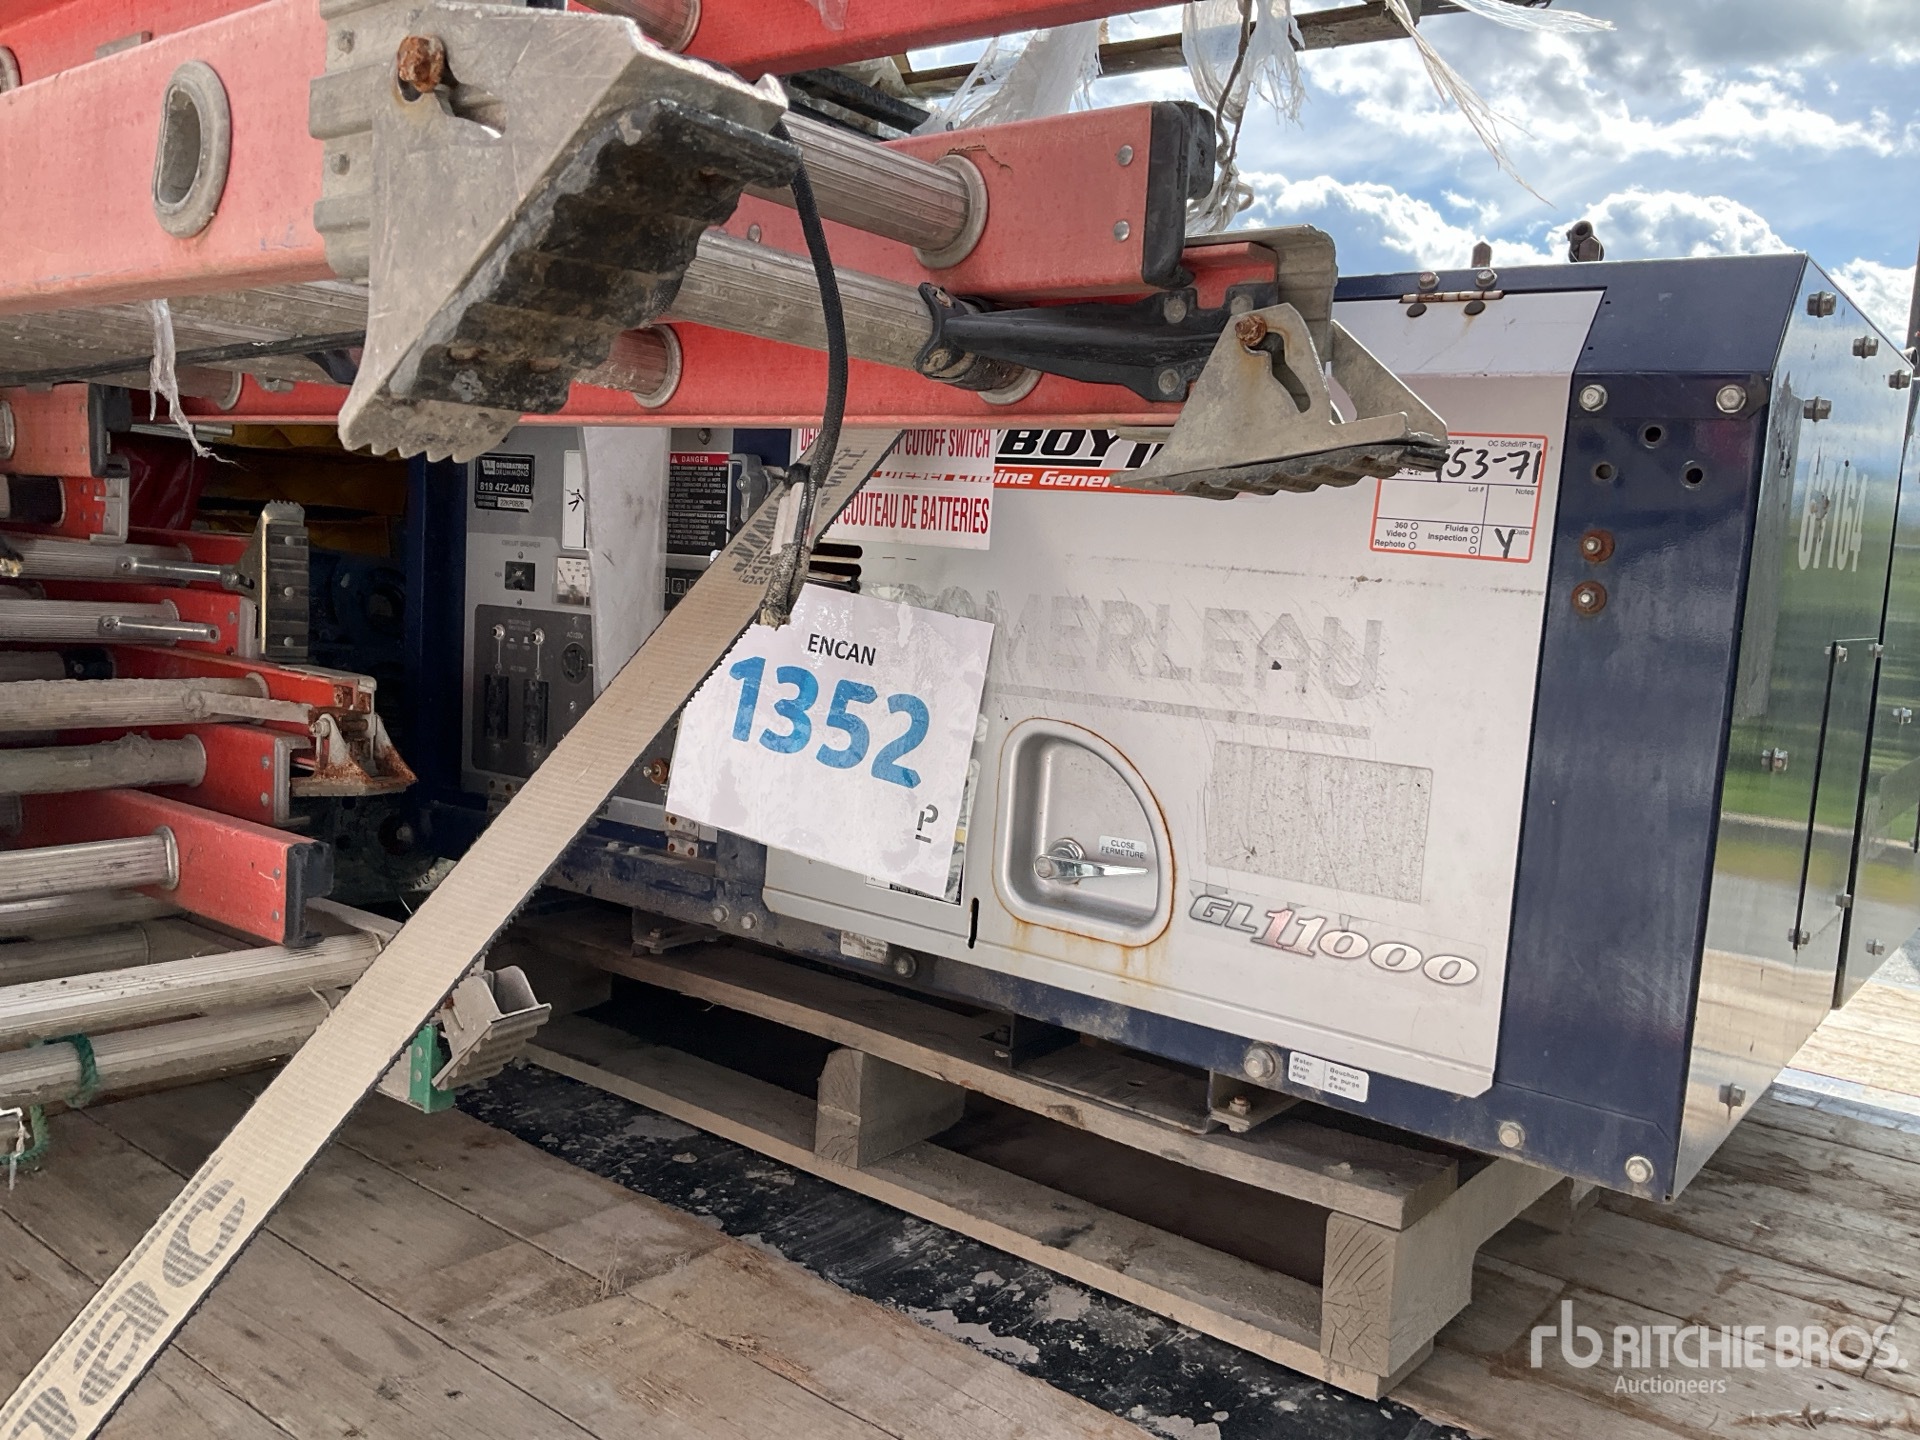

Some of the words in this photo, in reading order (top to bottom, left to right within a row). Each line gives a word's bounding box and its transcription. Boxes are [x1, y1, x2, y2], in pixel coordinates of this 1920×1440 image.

[949, 429, 990, 459] SWITCH
[1529, 441, 1541, 449] Tag
[480, 482, 493, 491] 819
[495, 483, 530, 493] 472-4076
[844, 492, 898, 529] COUTEAU
[902, 495, 917, 530] DE
[921, 496, 990, 535] BATTERIES
[1386, 530, 1407, 538] Video
[1445, 525, 1469, 533] Fluids
[1427, 533, 1468, 542] Inspection
[1374, 540, 1406, 548] Rephoto
[807, 633, 876, 666] ENCAN
[729, 656, 930, 789] 1352
[1110, 839, 1135, 849] CLOSE
[1101, 845, 1144, 859] FERMETURE
[1189, 894, 1478, 985] GL11000
[1293, 1056, 1313, 1067] Water
[1292, 1064, 1310, 1073] drain
[1329, 1067, 1359, 1080] Bouchon
